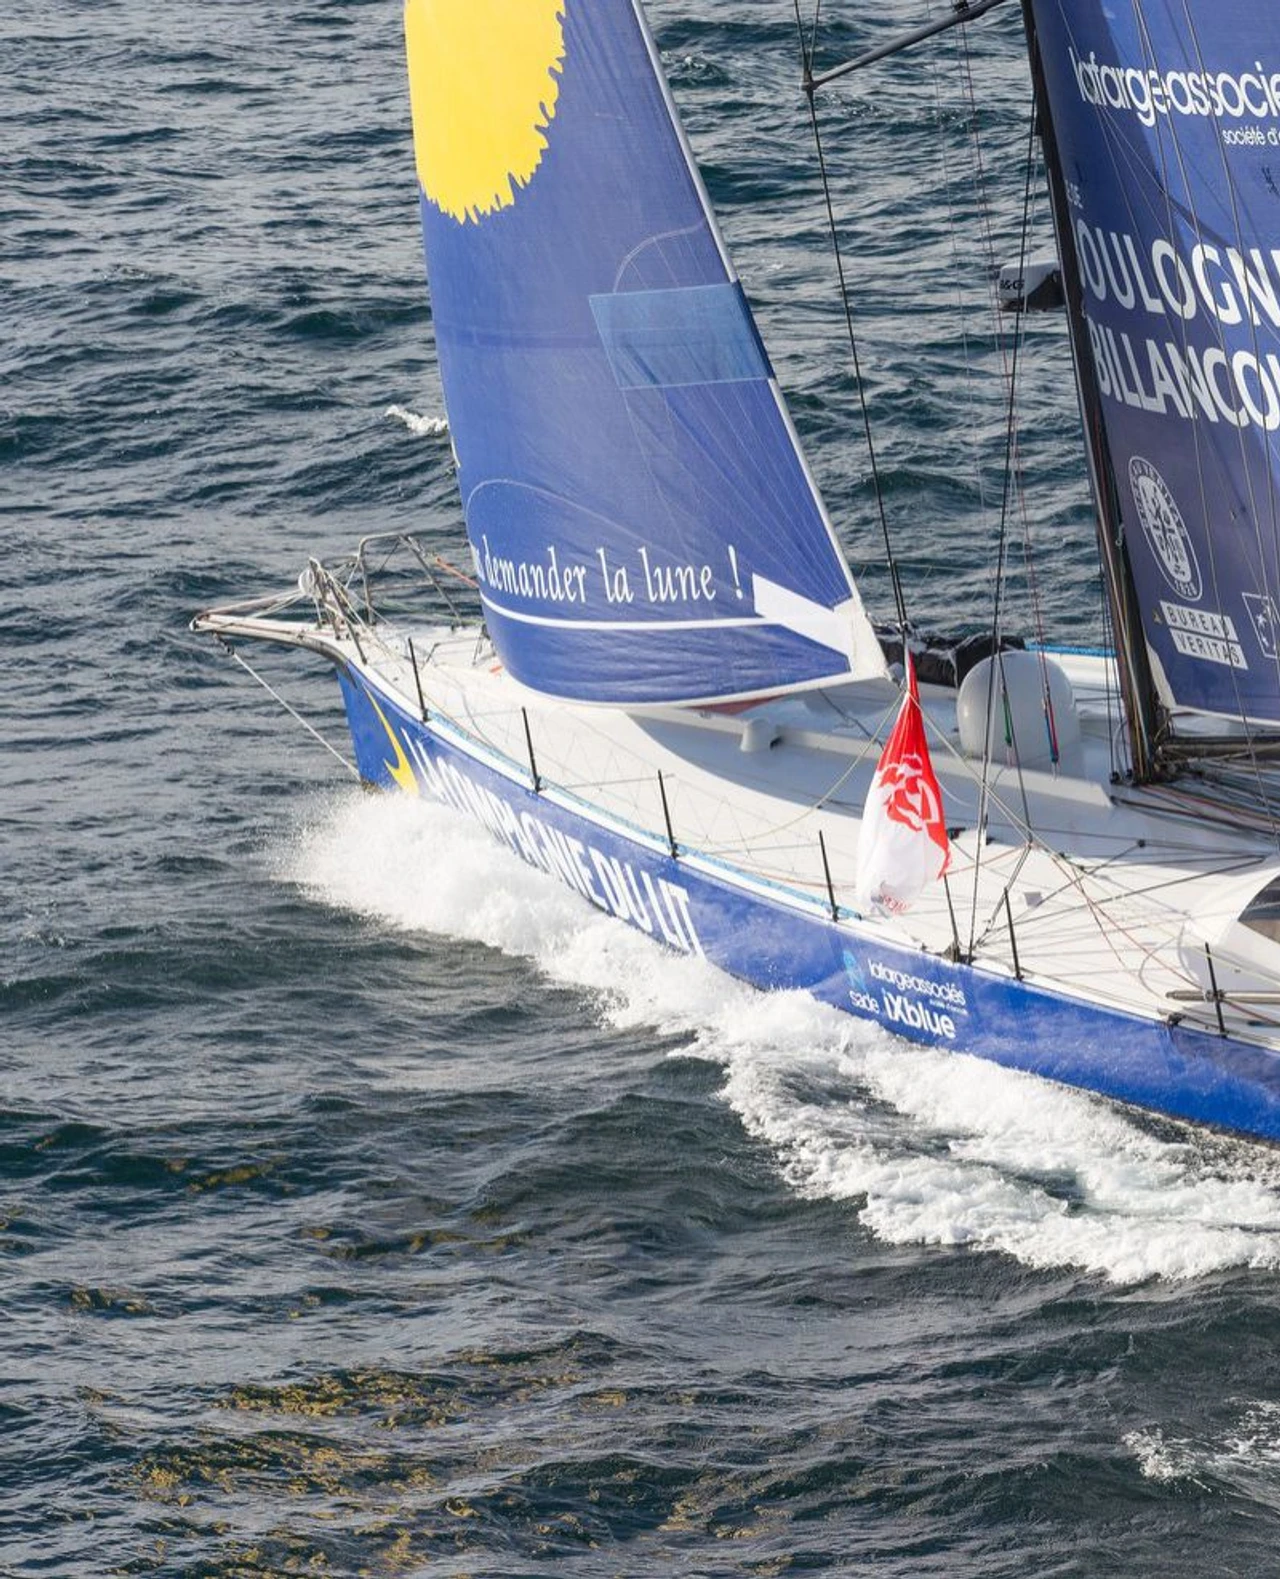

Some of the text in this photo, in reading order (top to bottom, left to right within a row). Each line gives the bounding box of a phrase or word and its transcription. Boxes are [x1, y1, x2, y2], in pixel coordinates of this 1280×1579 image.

[1222, 125, 1266, 147] société
[482, 533, 587, 603] demander
[597, 546, 634, 603] la
[638, 546, 718, 603] lune
[1166, 605, 1231, 638] BUREAU
[1177, 635, 1241, 666] VERITAS
[849, 989, 880, 1015] sade
[881, 986, 956, 1040] iXblue
